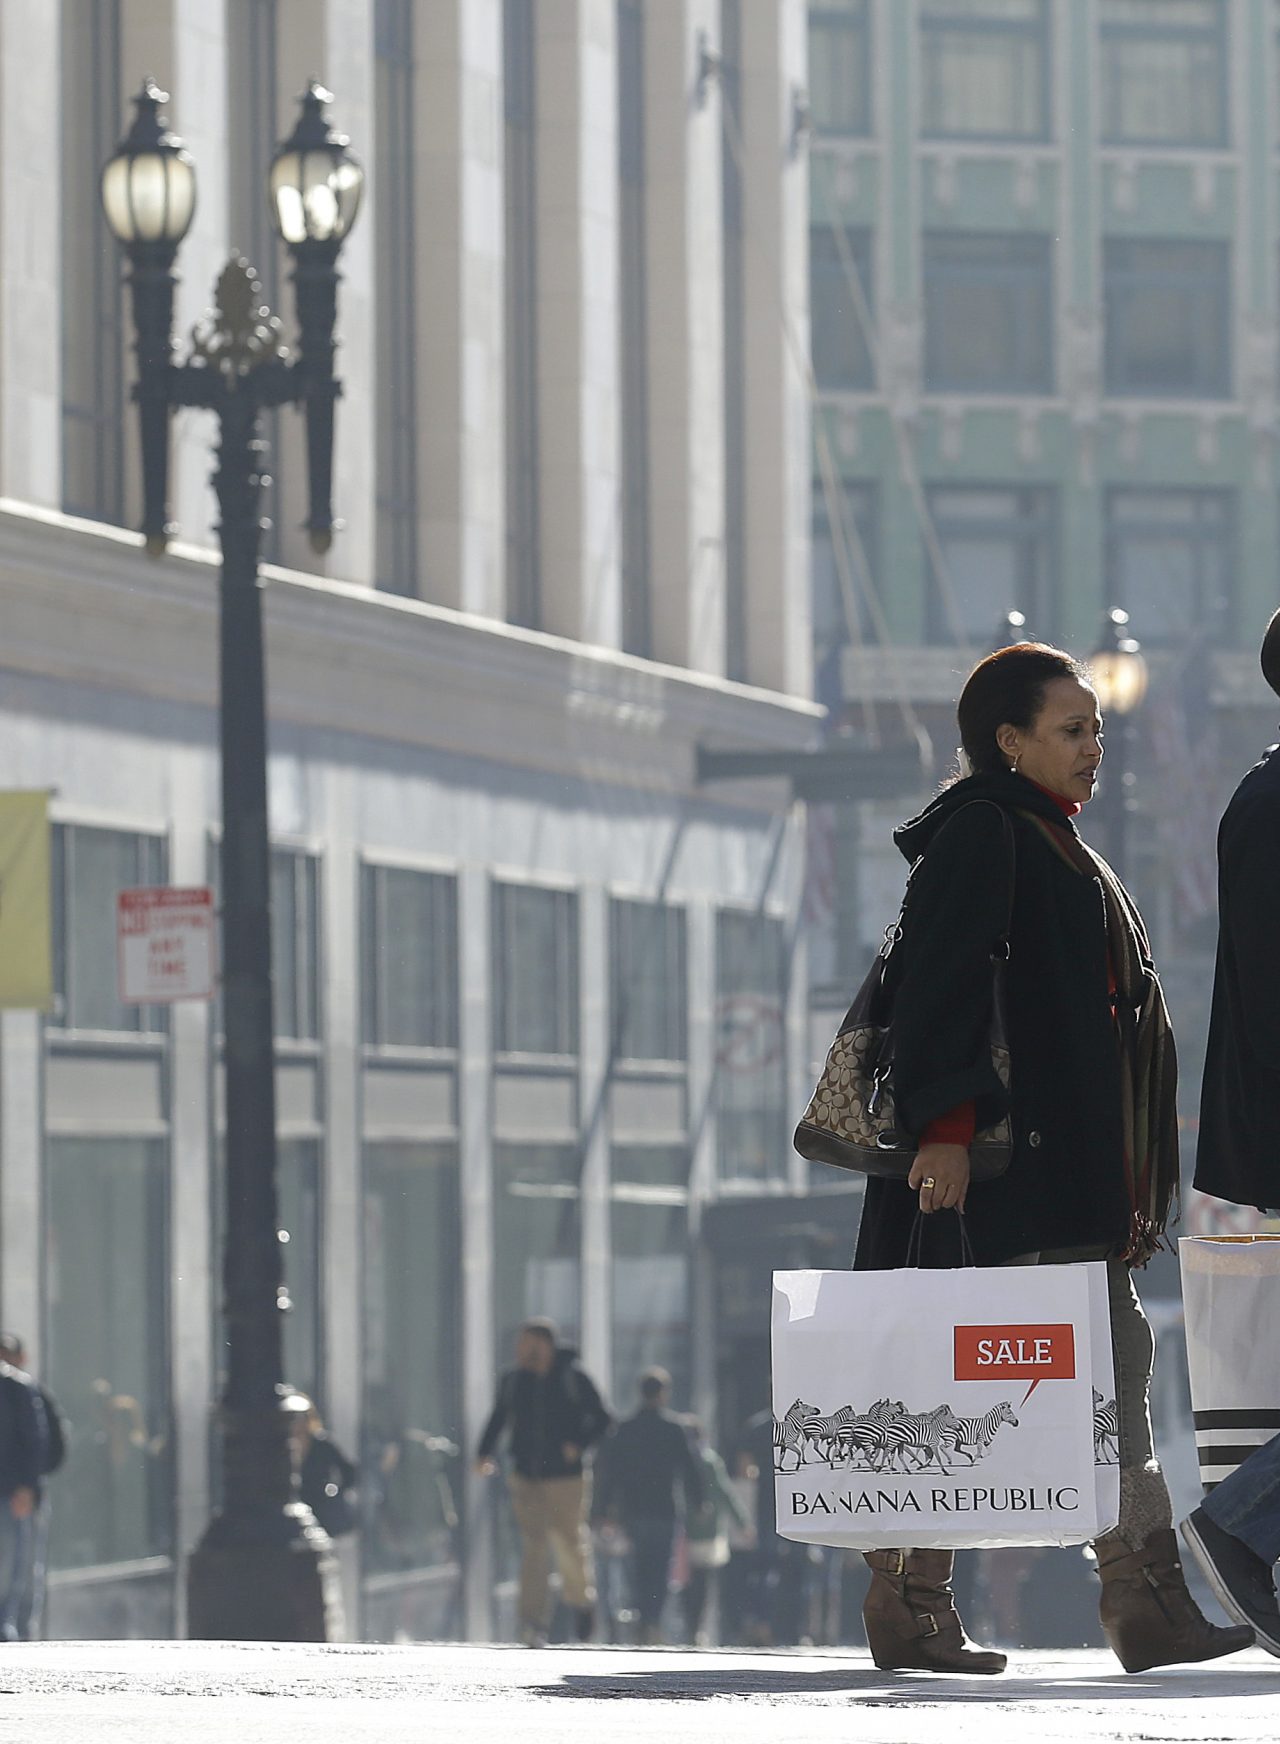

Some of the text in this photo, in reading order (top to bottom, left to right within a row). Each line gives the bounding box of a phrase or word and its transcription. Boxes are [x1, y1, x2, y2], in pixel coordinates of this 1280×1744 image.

[977, 1339, 1053, 1365] SALE
[791, 1486, 1079, 1515] BANANA REPUBLIC
